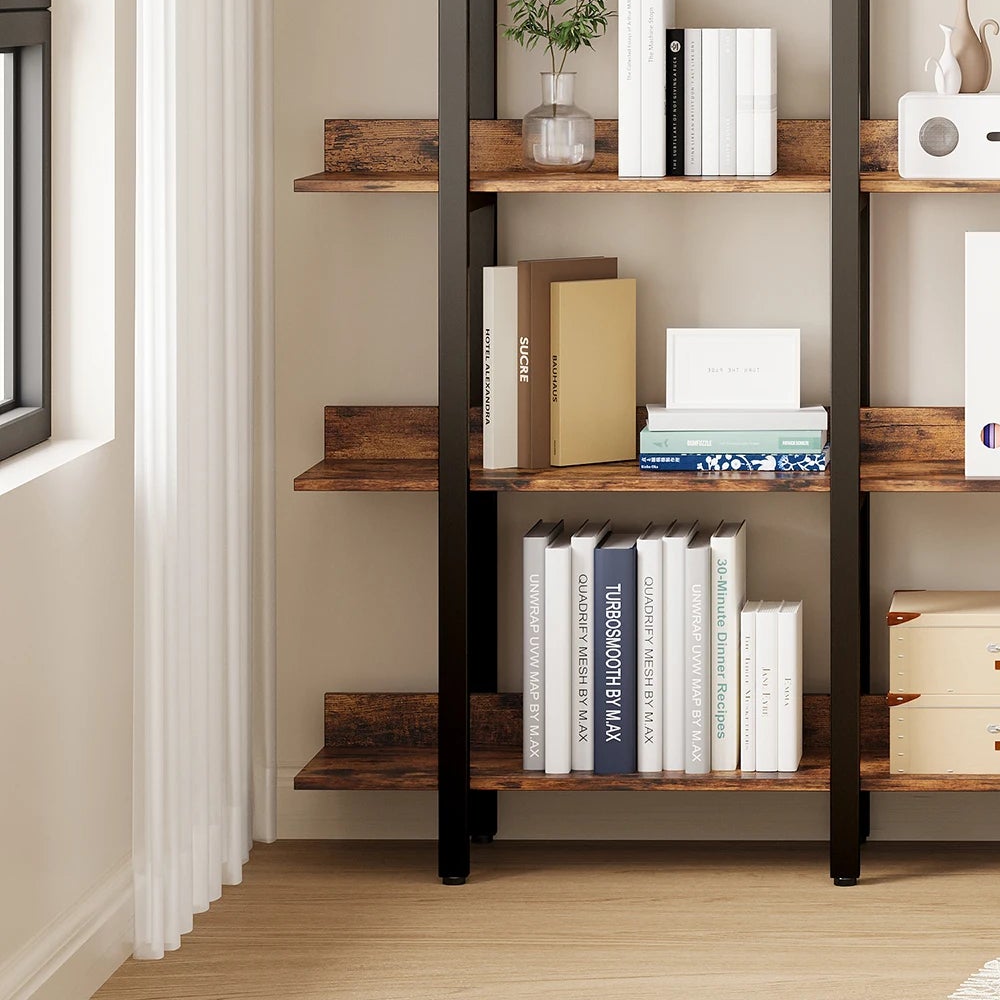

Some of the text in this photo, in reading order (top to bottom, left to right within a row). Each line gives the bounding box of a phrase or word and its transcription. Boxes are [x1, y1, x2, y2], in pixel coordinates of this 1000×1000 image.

[519, 336, 529, 383] SUCRE
[529, 574, 540, 758] UNWRAP UVW MAP BY M.AX
[578, 573, 588, 743] QUADRIFY MESH BY M.AX
[605, 583, 621, 742] TURBOSMOOTH BY M.AX
[644, 576, 654, 744] QUADRIFY MESH BY M.AX
[691, 584, 701, 762] UNWRAP UVW MAP BY M.AX
[717, 559, 727, 739] 30-Minute Dinner Recipes
